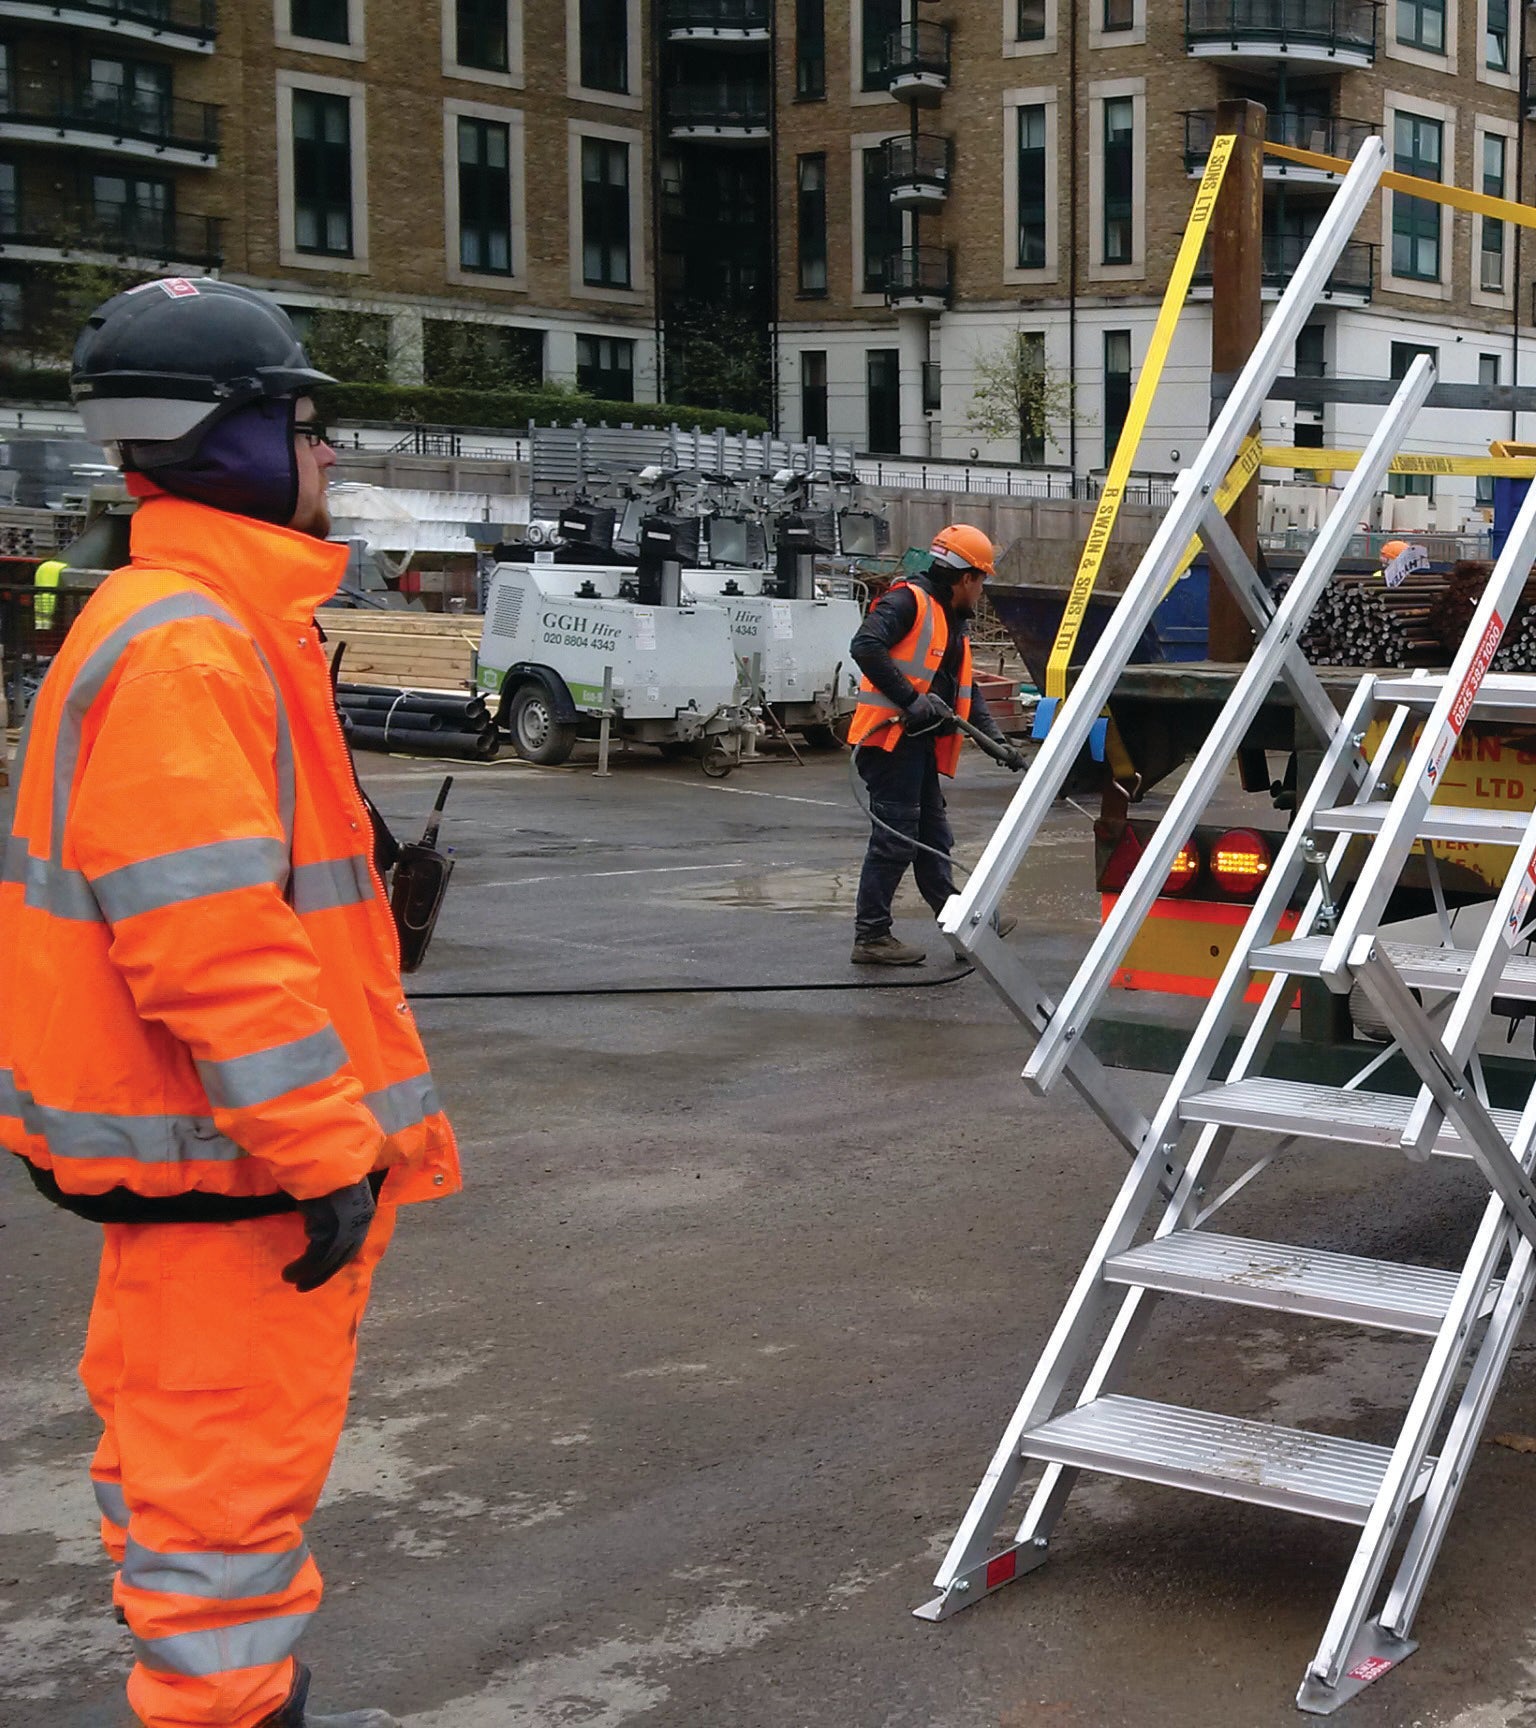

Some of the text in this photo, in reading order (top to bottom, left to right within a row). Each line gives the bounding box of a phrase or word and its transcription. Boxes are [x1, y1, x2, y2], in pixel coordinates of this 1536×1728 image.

[1192, 138, 1230, 222] & SONS LTD
[1056, 488, 1119, 651] R SWAIN & SONS LTD
[542, 612, 588, 633] GGH
[591, 621, 622, 638] Hire
[735, 610, 762, 625] Hire
[543, 632, 615, 651] 020 8804 4343
[1455, 626, 1499, 727] 0845 382 1000
[1475, 777, 1524, 799] LTD
